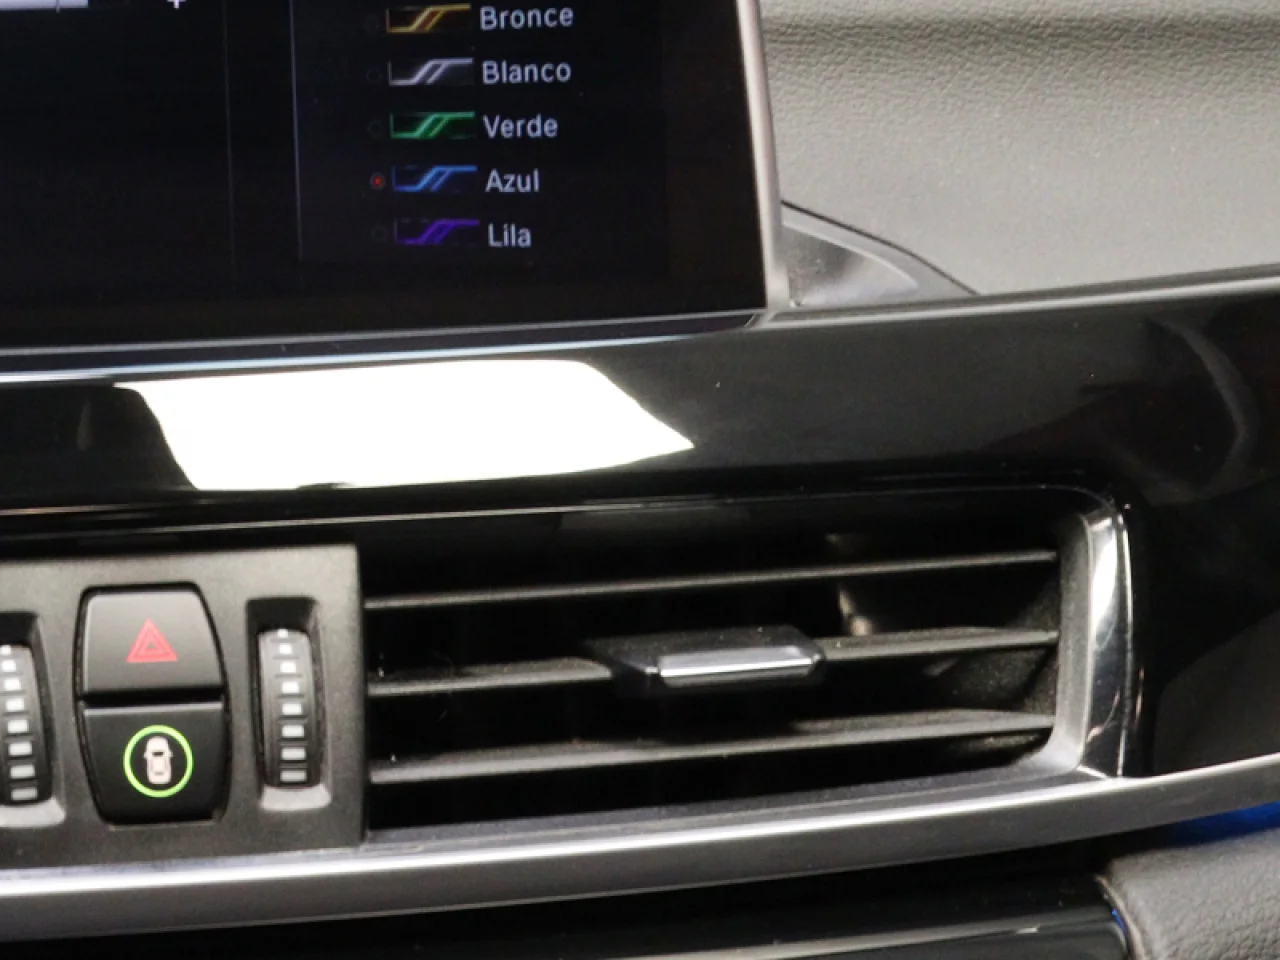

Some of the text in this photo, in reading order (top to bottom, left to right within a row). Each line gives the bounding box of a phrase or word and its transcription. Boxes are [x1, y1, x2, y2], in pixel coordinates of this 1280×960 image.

[480, 5, 574, 31] Bronce
[482, 60, 572, 84] Blanco
[482, 114, 559, 138] Verde
[485, 168, 540, 193] Azul
[488, 223, 532, 248] Lila
